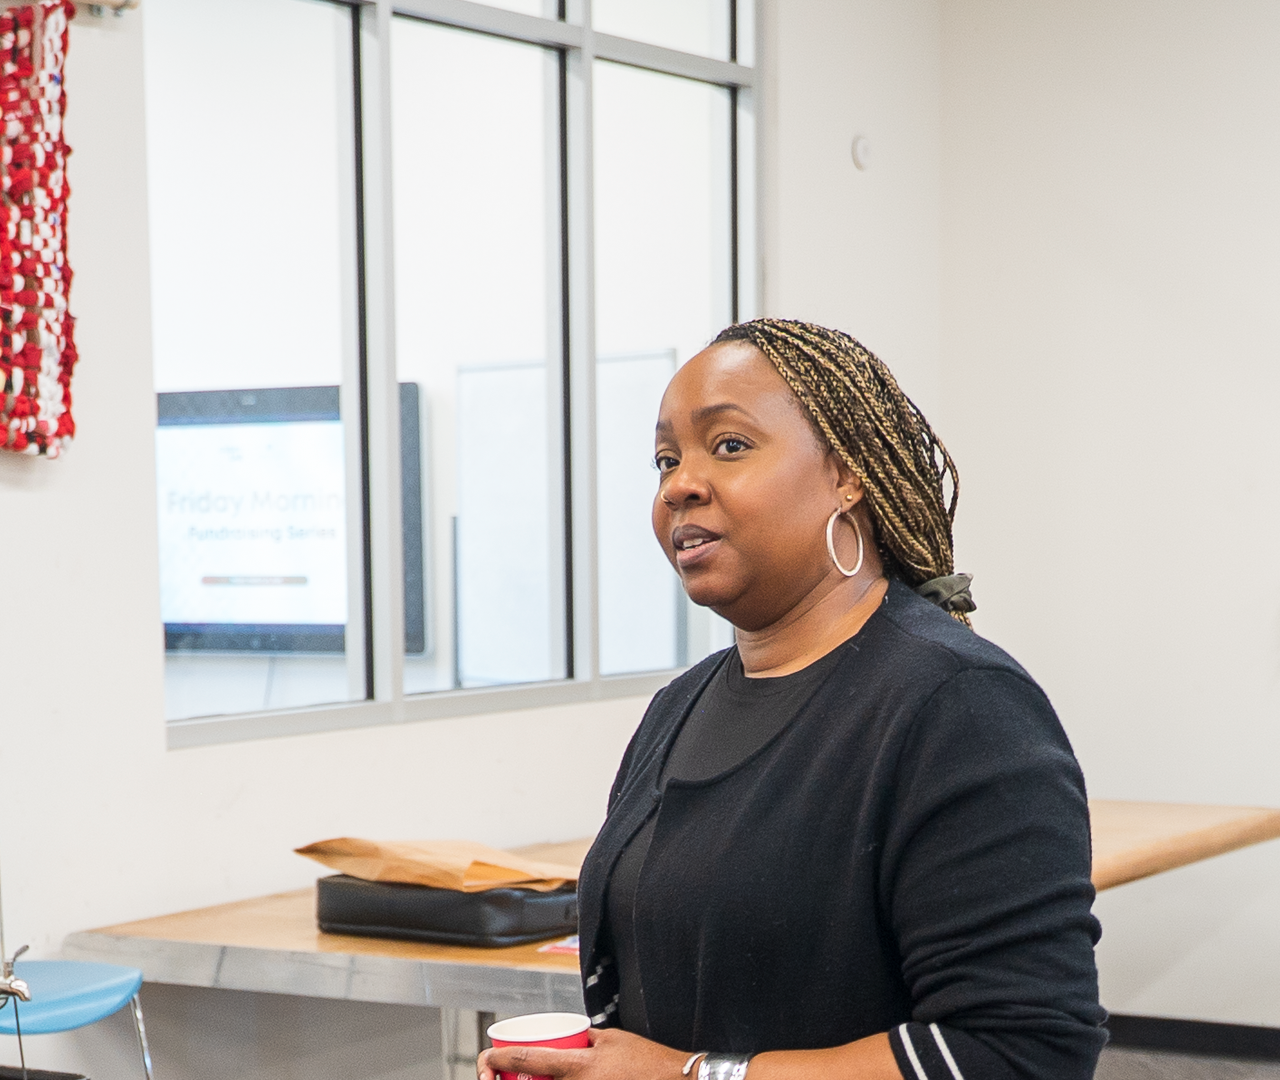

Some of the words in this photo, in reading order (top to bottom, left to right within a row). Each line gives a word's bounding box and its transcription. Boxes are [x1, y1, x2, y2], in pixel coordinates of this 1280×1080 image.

[167, 490, 245, 518] Friday
[251, 488, 343, 513] Mornin
[188, 526, 282, 543] Fundraising
[287, 525, 336, 540] Series
